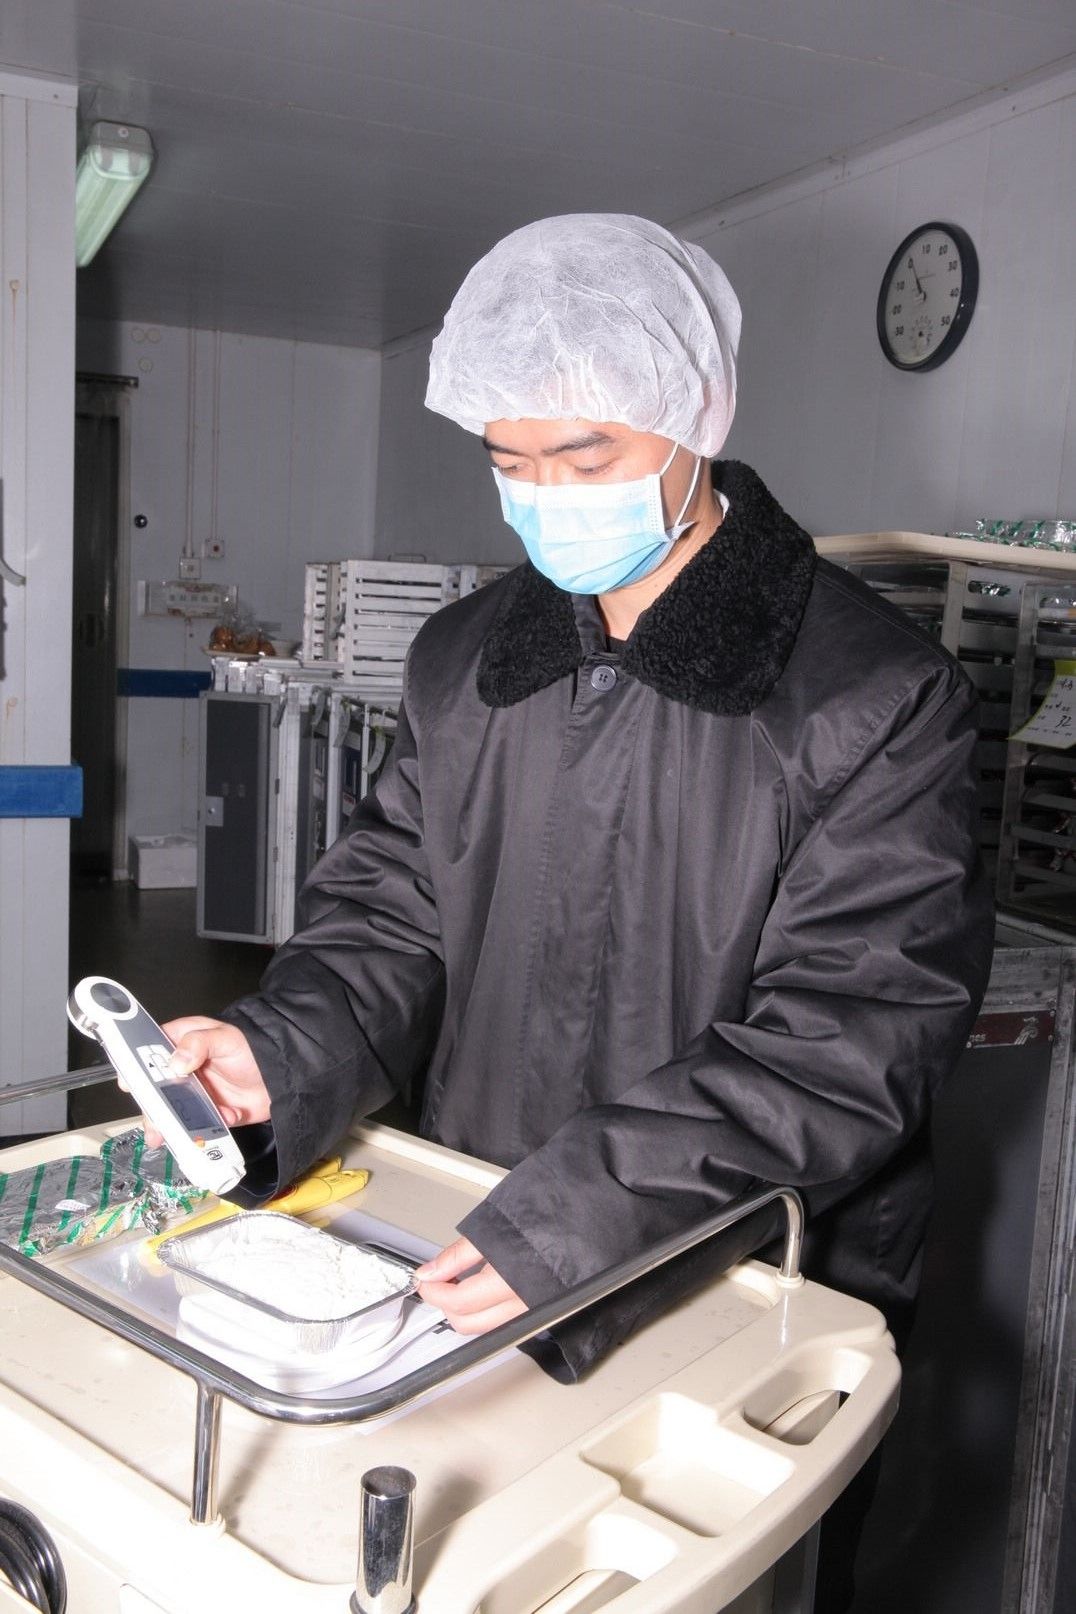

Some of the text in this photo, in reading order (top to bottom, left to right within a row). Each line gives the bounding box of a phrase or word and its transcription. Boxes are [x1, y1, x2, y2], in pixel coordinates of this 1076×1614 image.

[922, 244, 931, 254] 10
[939, 244, 948, 255] 20
[949, 287, 960, 298] 40
[940, 315, 951, 326] 50
